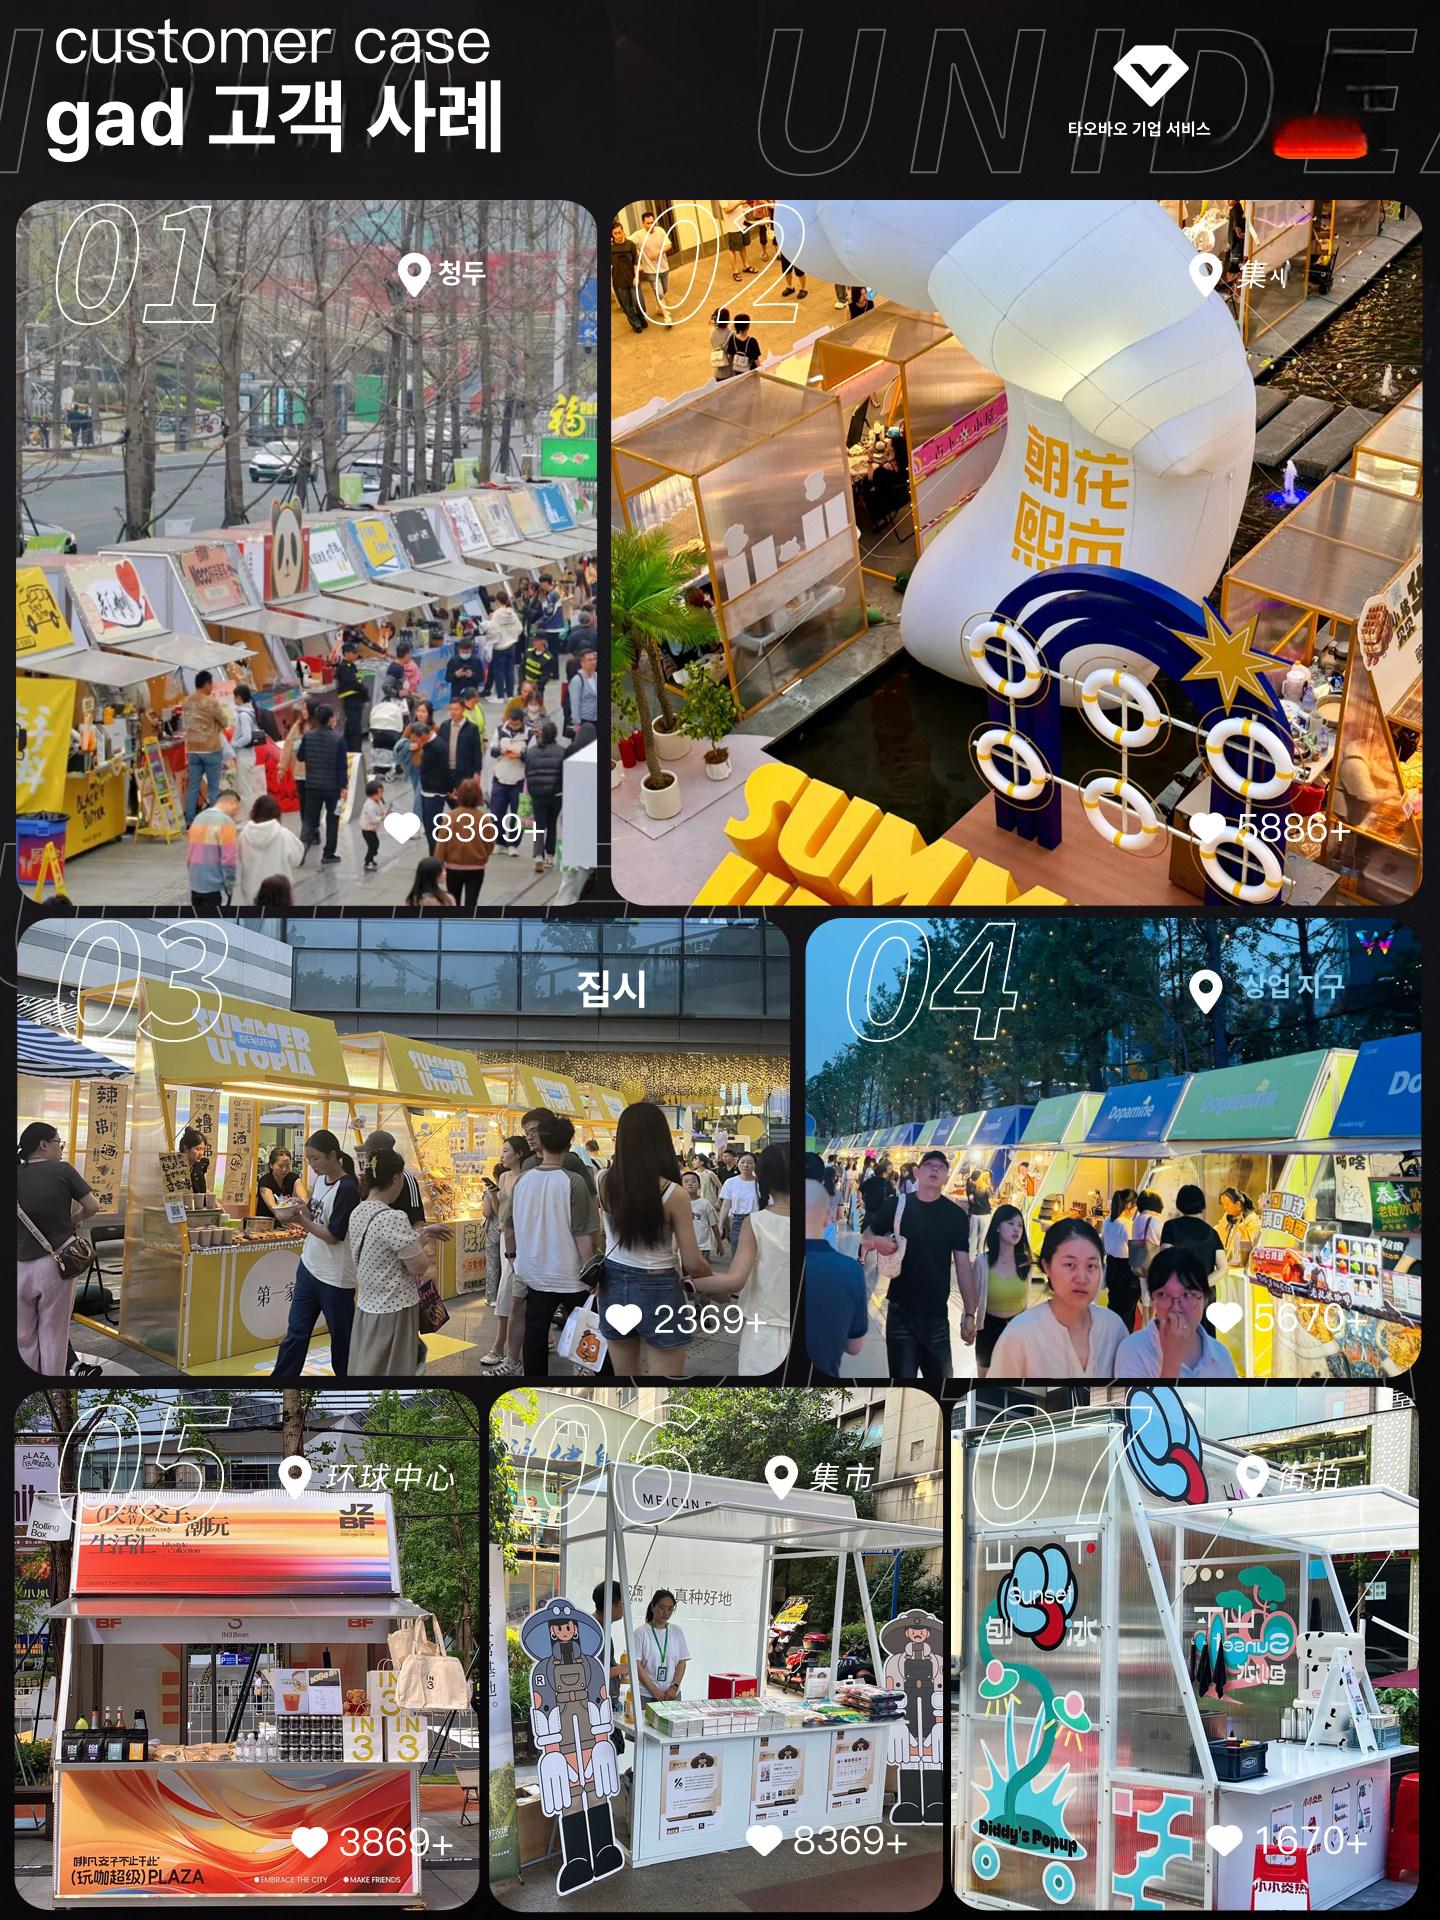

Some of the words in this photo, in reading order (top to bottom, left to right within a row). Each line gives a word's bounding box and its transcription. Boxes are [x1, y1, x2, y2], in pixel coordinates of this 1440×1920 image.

[191, 1007, 312, 1052] SUMMER
[207, 1036, 316, 1076] UTOPIA
[408, 1050, 469, 1080] SUMMER
[418, 1070, 474, 1097] UTOPIA
[96, 1085, 118, 1104] 辣
[1107, 1102, 1155, 1122] Dopamine
[23, 1451, 51, 1462] PLAZA
[339, 1503, 374, 1516] JZ
[643, 1492, 699, 1510] MEICUN
[32, 1520, 60, 1532] Rolling
[339, 1516, 375, 1529] BF
[31, 1529, 47, 1538] Box
[1008, 1584, 1073, 1605] Sunset
[95, 1618, 122, 1629] BF
[347, 1618, 374, 1628] BF
[537, 1676, 544, 1685] R
[380, 1689, 399, 1716] 3
[351, 1716, 375, 1733] IN
[396, 1716, 420, 1733] IN
[352, 1734, 375, 1762] 3
[397, 1734, 420, 1762] 3
[978, 1818, 1030, 1846] Diddy's
[1032, 1828, 1078, 1858] Popup
[148, 1869, 205, 1886] PLAZA
[260, 1875, 294, 1884] EMBRACE
[296, 1875, 310, 1884] THE
[312, 1875, 328, 1884] CITY
[350, 1875, 369, 1884] MAKE
[371, 1875, 401, 1884] FRIENDS
